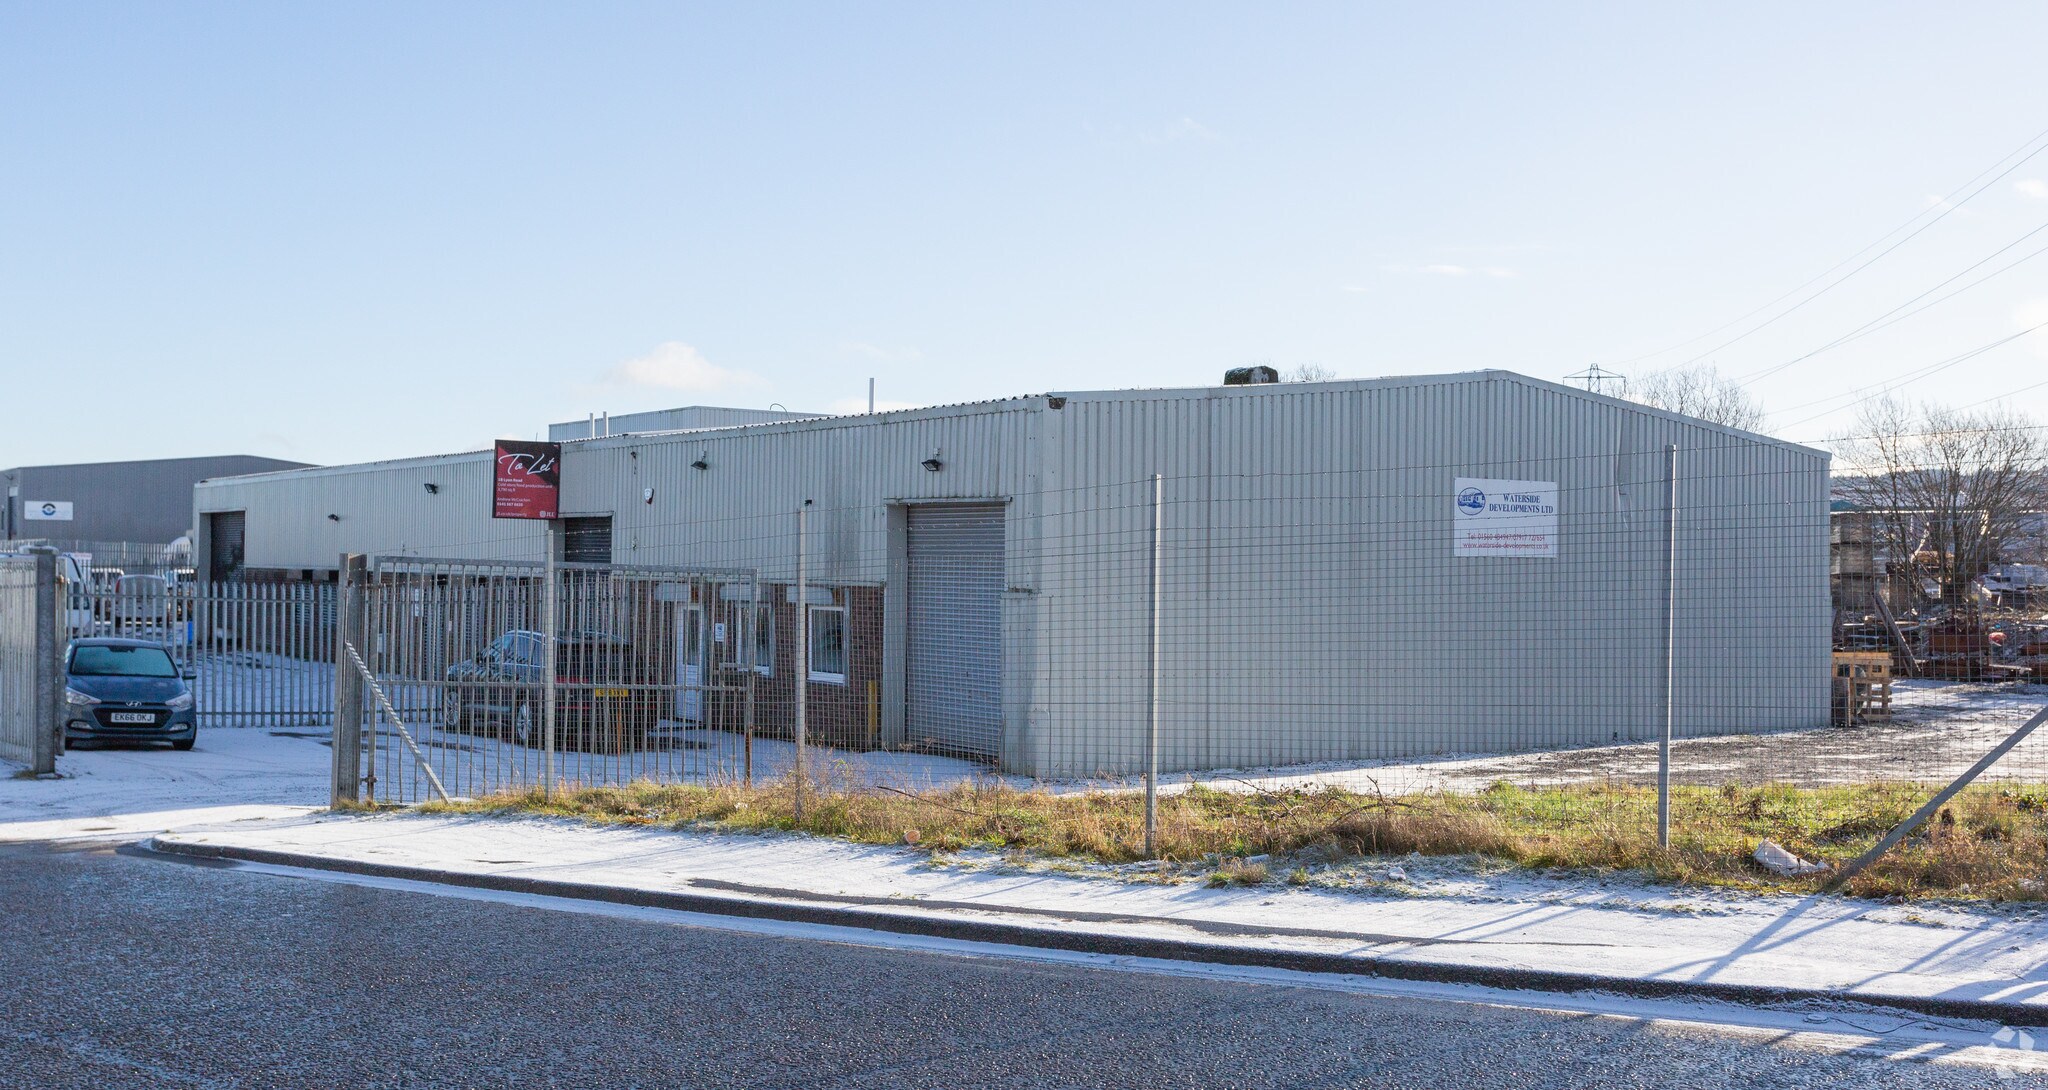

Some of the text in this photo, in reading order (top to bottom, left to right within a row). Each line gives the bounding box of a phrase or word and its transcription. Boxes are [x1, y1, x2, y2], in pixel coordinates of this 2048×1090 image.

[498, 452, 555, 475] To Let
[1503, 493, 1541, 503] WATERSIDE
[1489, 503, 1554, 514] DEVELOPMENTS LTD
[114, 713, 152, 721] EK66 OKJ
